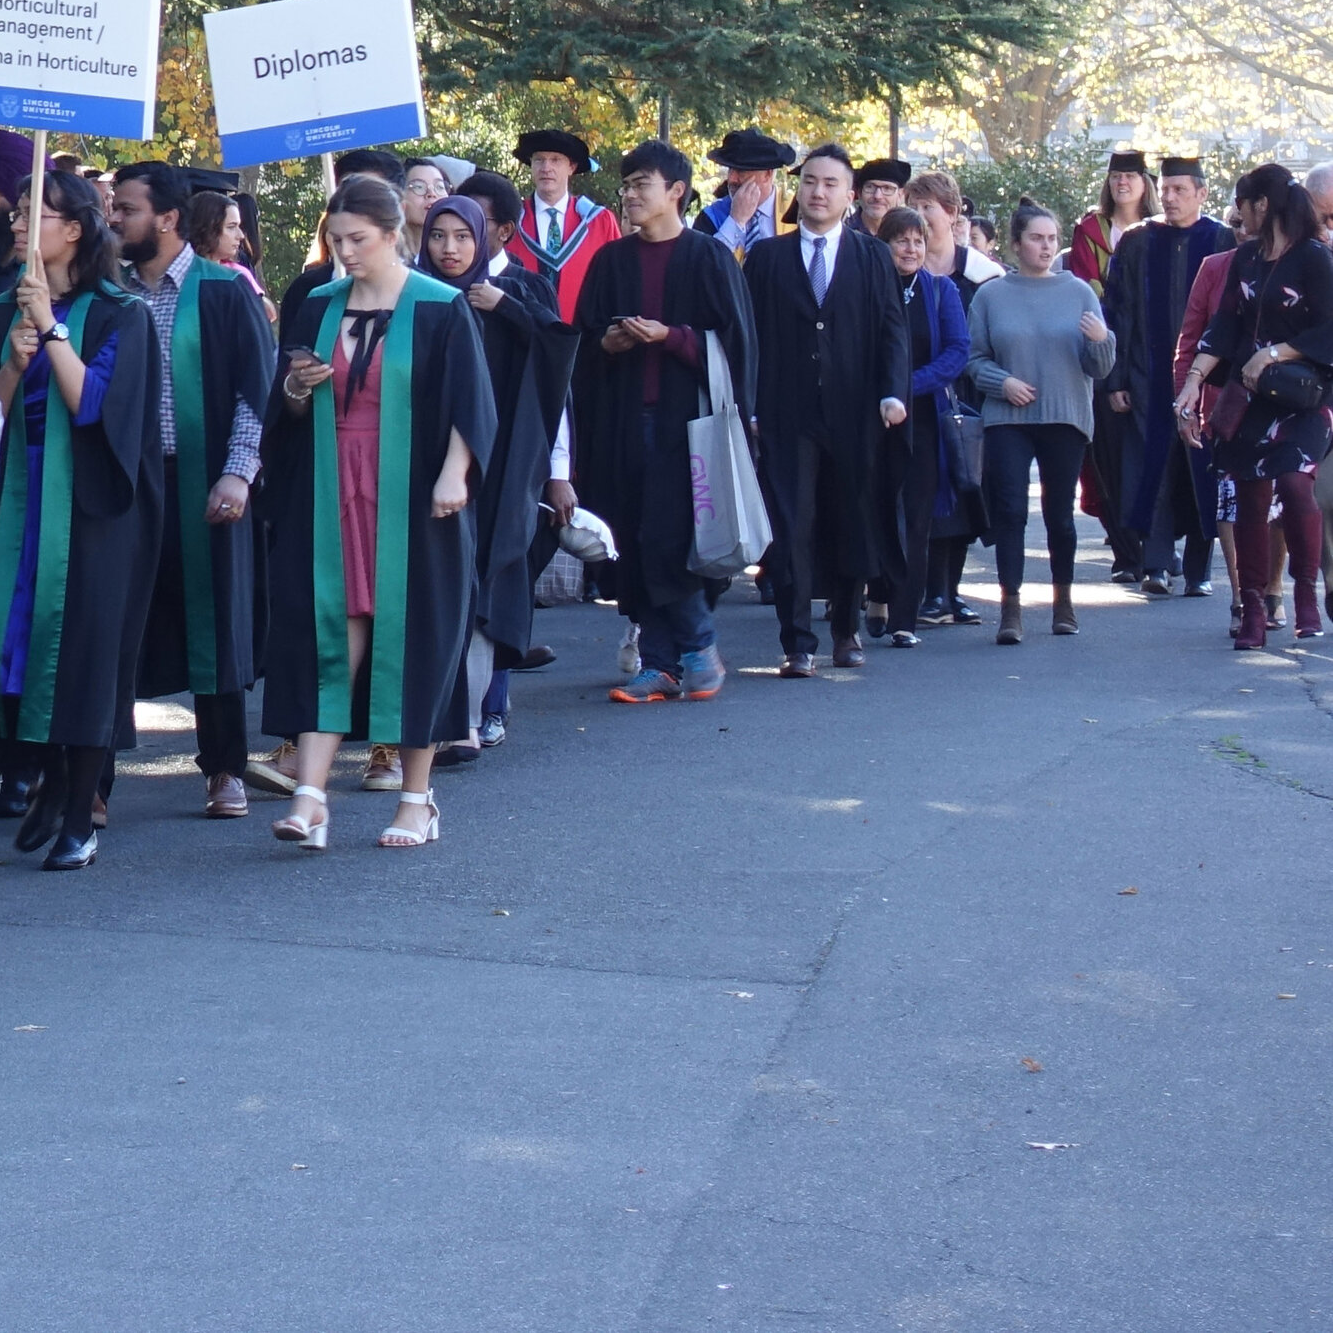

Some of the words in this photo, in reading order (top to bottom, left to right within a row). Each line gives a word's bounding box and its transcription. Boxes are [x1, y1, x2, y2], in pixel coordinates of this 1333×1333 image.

[96, 25, 105, 45] /
[17, 49, 32, 67] in
[37, 51, 137, 78] Horticulture
[254, 44, 368, 80] Diplomas
[22, 106, 76, 117] UNIVERSITY
